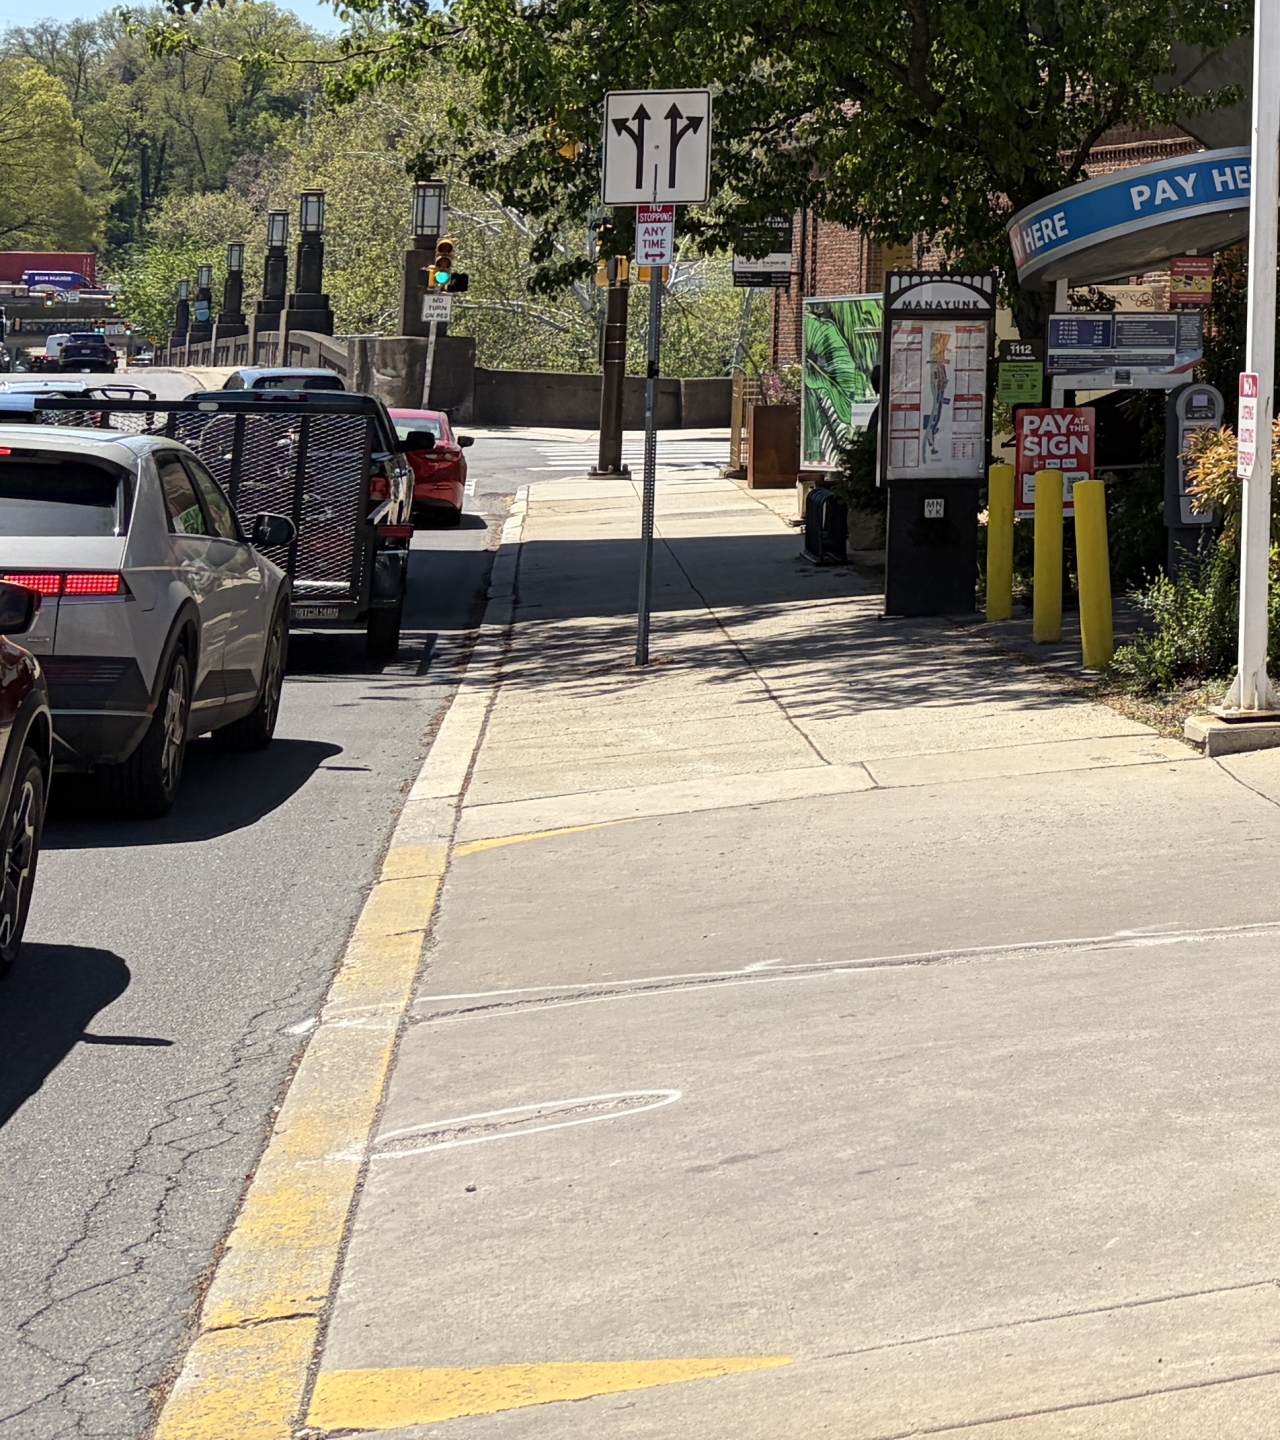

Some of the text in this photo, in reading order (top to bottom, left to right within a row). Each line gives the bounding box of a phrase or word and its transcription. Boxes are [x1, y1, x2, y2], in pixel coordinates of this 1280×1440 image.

[1129, 165, 1251, 211] PAY HE
[639, 212, 673, 222] STOPPING
[643, 226, 666, 236] ANY
[1023, 211, 1069, 253] HERE
[642, 239, 667, 249] TIME
[902, 300, 979, 309] MANAYUNK
[1010, 344, 1032, 354] 1112
[1023, 414, 1073, 435] PAY
[1069, 424, 1090, 432] THIS
[1023, 435, 1089, 457] SIGN
